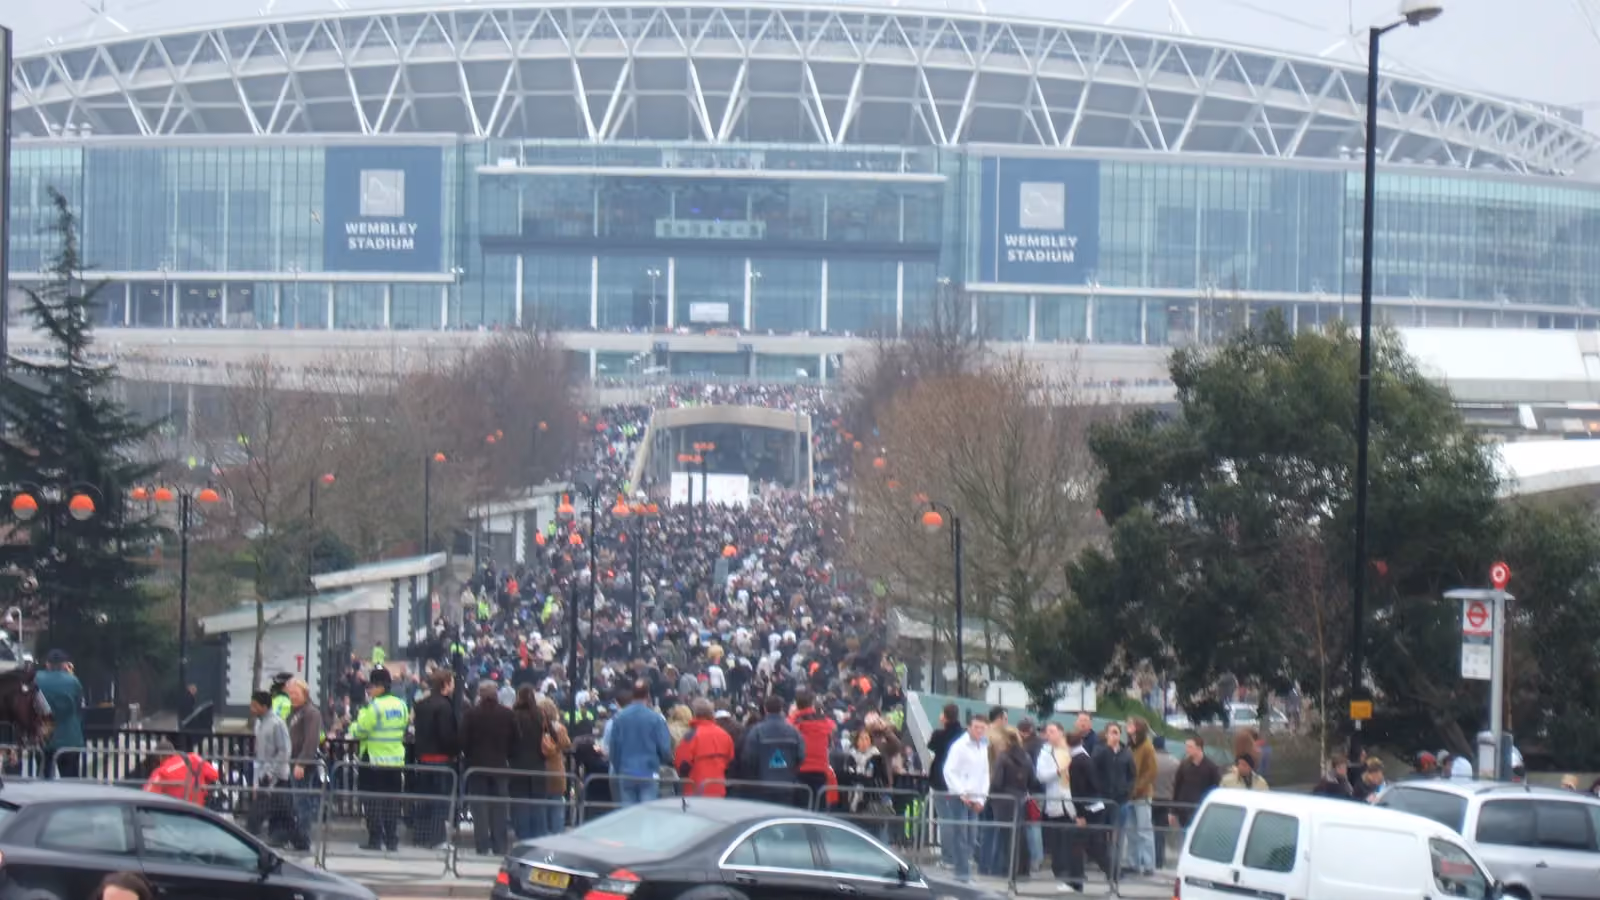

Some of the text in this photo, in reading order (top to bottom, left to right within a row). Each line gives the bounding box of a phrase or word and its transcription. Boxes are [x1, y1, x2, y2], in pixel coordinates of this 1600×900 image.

[345, 222, 417, 235] WEMBLEY
[348, 237, 414, 250] STADIUM
[1004, 234, 1078, 248] WEMBLEY
[1007, 249, 1075, 263] STADIUM
